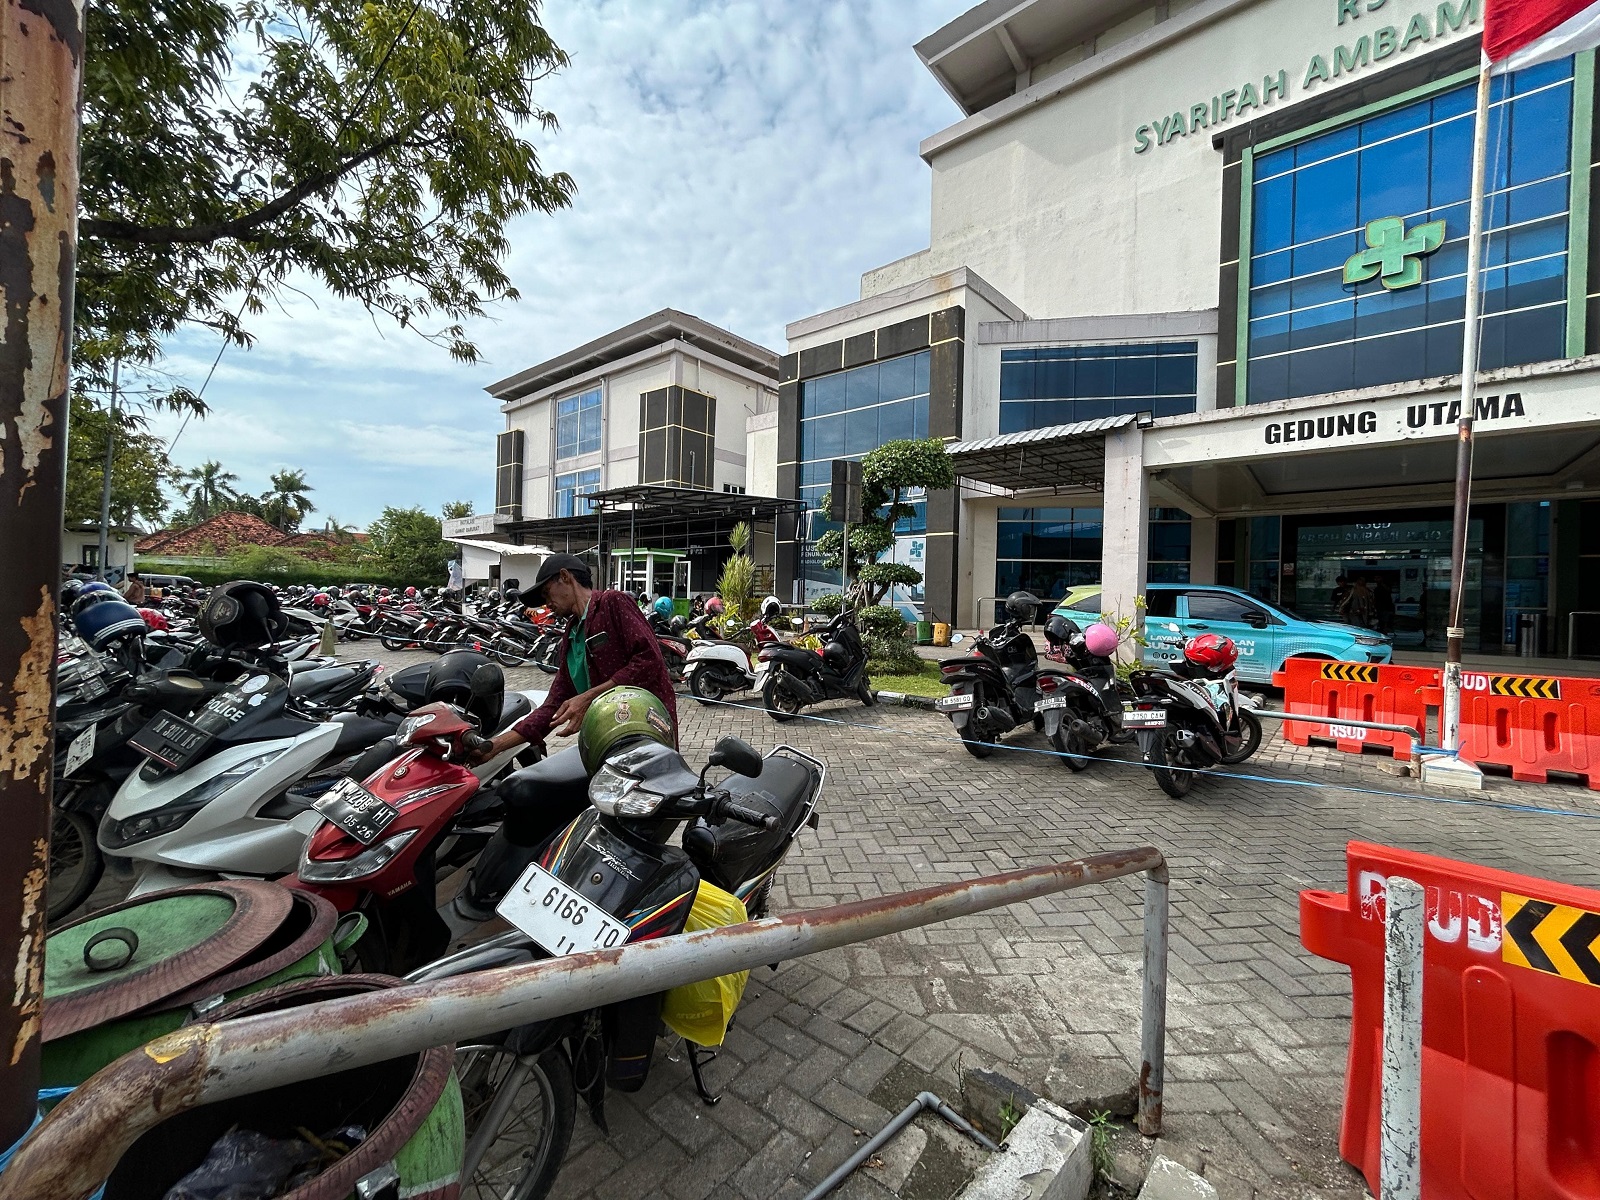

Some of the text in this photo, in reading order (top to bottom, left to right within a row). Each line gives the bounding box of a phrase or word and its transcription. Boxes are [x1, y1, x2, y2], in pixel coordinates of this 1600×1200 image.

[1133, 0, 1483, 154] SYARIFAH AMBAM
[1264, 392, 1526, 445] GEDUNG UTAMA
[203, 699, 246, 722] POLICE
[1329, 724, 1367, 740] RSUD
[372, 806, 395, 825] HT
[387, 880, 412, 896] YAMAHA
[523, 872, 537, 893] L
[542, 886, 589, 926] 6166
[1359, 870, 1502, 953] RUD
